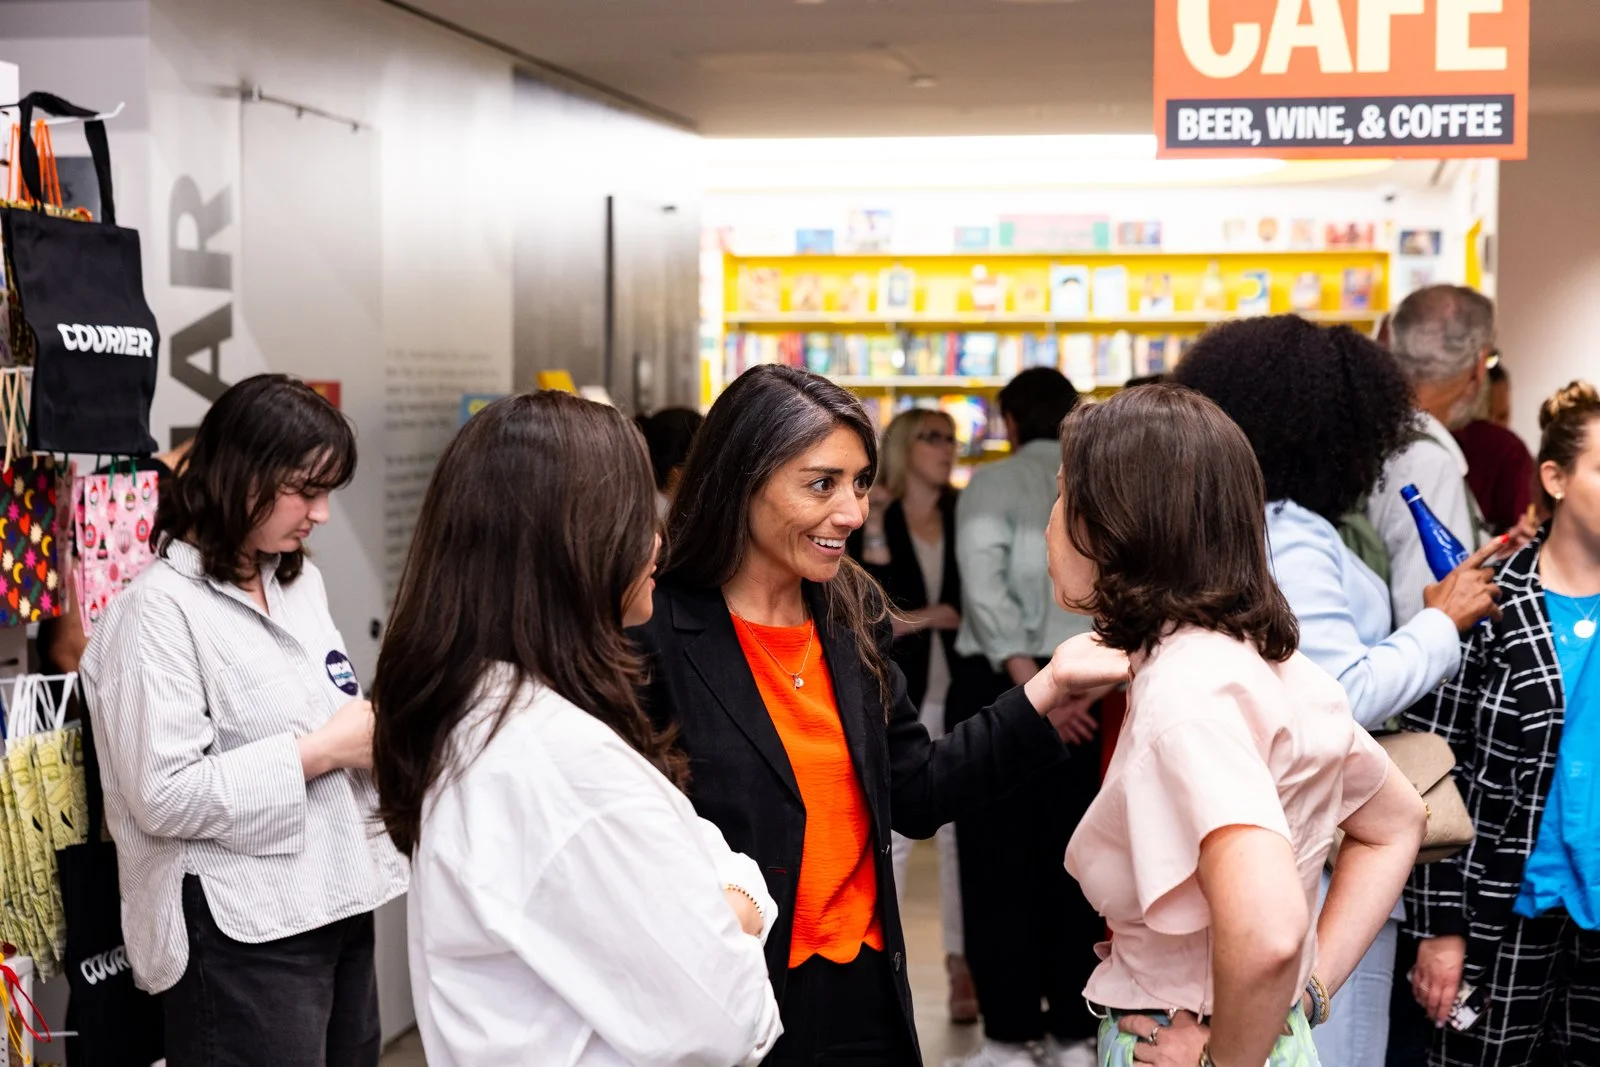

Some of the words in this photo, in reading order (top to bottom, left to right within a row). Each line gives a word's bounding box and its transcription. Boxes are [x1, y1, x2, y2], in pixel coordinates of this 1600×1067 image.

[1177, 0, 1507, 78] CAFE
[1178, 107, 1261, 146] BEER,
[1265, 106, 1353, 145] WINE,
[1357, 105, 1386, 140] &
[1389, 103, 1503, 139] COFFEE
[169, 174, 233, 452] AR
[57, 323, 153, 358] COURIER
[80, 945, 132, 985] COUR
